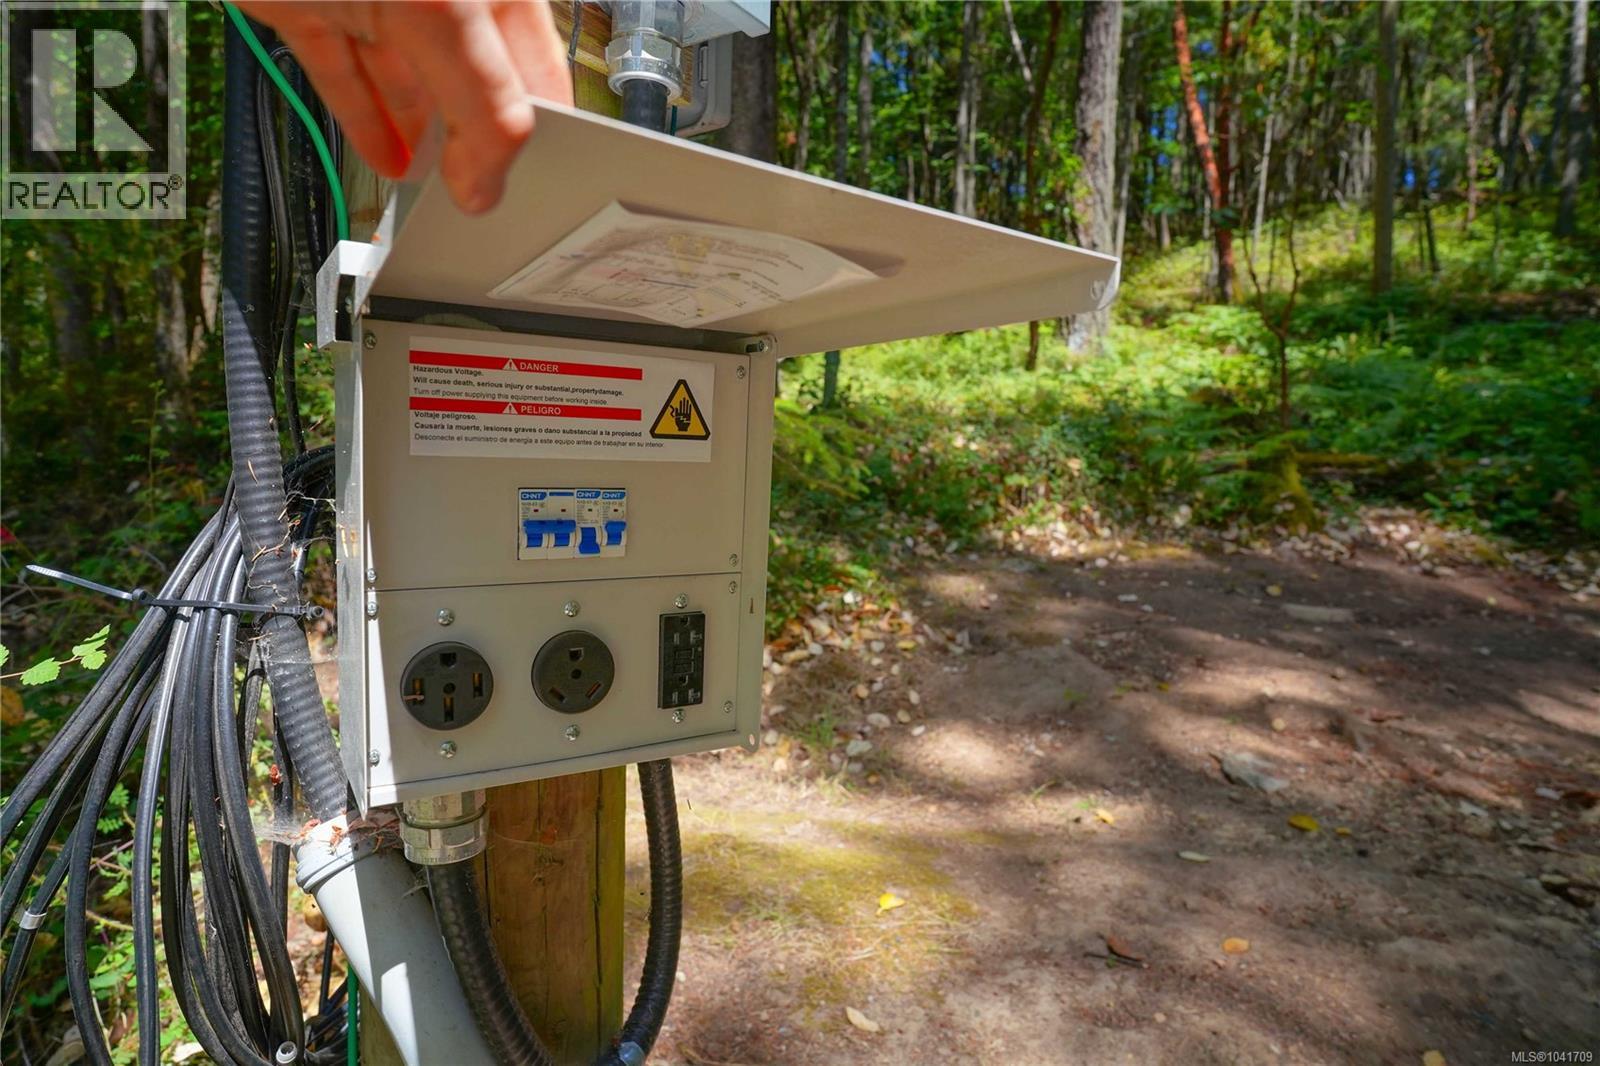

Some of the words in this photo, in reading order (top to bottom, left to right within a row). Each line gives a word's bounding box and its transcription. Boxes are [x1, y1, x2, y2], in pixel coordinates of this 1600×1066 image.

[413, 365, 453, 374] Hazardous
[454, 368, 484, 377] Voltage.
[520, 362, 559, 372] DANGER
[413, 376, 428, 384] Will
[428, 378, 451, 386] cause
[453, 379, 475, 387] death,
[504, 382, 524, 390] injury
[442, 390, 463, 398] power
[464, 391, 496, 400] supplying
[497, 392, 509, 400] this
[510, 393, 544, 402] equipment
[565, 396, 589, 405] working
[521, 405, 562, 415] PELIGRO
[414, 411, 440, 420] Voltaje
[442, 412, 477, 420] peligroso.
[414, 433, 455, 441] Desconecte
